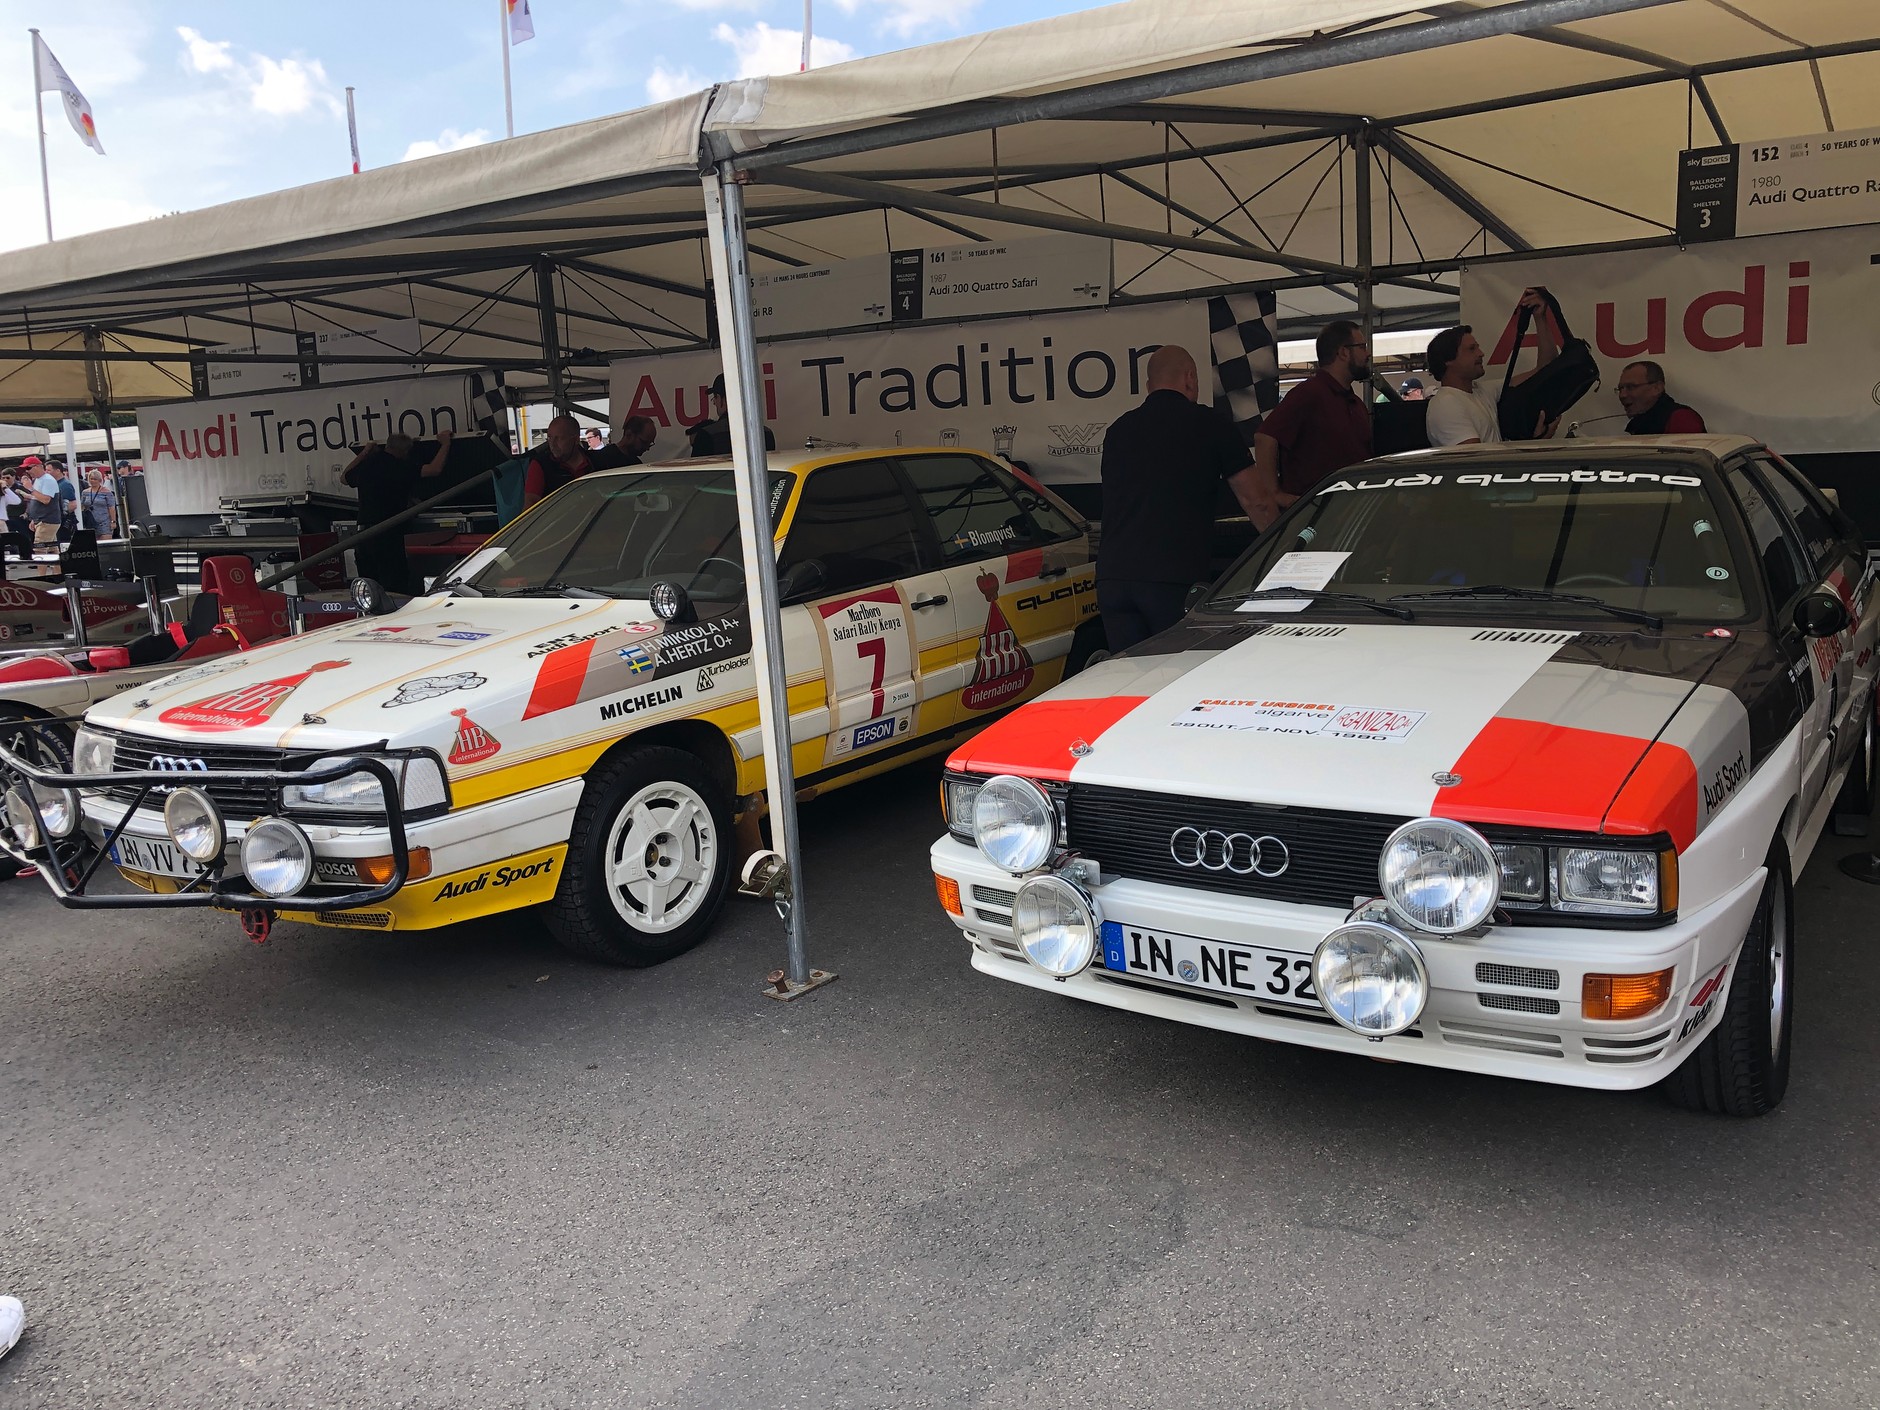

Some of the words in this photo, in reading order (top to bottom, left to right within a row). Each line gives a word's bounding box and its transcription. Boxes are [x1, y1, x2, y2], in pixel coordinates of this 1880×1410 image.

[1752, 146, 1779, 162] 152
[1821, 143, 1832, 152] 50
[1834, 140, 1858, 149] YEARS
[1860, 138, 1870, 146] OF
[1687, 159, 1701, 167] sky
[1703, 155, 1729, 165] sports
[1690, 176, 1726, 186] BALLROOM
[1691, 183, 1724, 191] PADDOCK
[1751, 175, 1781, 188] 1980
[1693, 200, 1720, 208] SHELTER
[1749, 190, 1786, 206] Audi
[1792, 185, 1860, 202] Quattro
[1700, 209, 1711, 228] 3
[930, 252, 945, 263] 161
[929, 286, 950, 296] Audi
[952, 284, 969, 294] 200
[971, 281, 1009, 293] Quattro
[1011, 277, 1038, 289] Safari
[930, 274, 947, 283] 1987
[762, 306, 773, 316] R8
[902, 296, 910, 310] 4
[319, 335, 328, 343] 227
[307, 367, 312, 378] 6
[622, 363, 778, 428] Aui
[151, 413, 239, 461] Audi
[250, 398, 458, 454] Tradition
[992, 425, 1017, 436] HORCH
[1316, 473, 1441, 496] Audi
[1456, 470, 1702, 487] quattro
[968, 526, 1016, 547] Blomqvist
[71, 551, 97, 559] BOSCH
[1017, 579, 1098, 611] quatt
[94, 604, 128, 613] Power
[847, 604, 881, 623] Marlboro
[1082, 604, 1099, 615] MICH
[645, 623, 720, 652] H.MIKKOLA
[721, 618, 740, 630] A+
[833, 625, 857, 641] Safari
[858, 621, 879, 637] Rally
[879, 616, 901, 633] Kenya
[527, 643, 568, 659] Audi
[569, 625, 620, 644] Sport
[655, 639, 712, 668] A.HERTZ
[980, 630, 1021, 683] HB
[706, 656, 751, 676] Turbolader
[857, 637, 887, 720] 7
[201, 684, 294, 712] HB
[970, 674, 1026, 705] international
[600, 685, 683, 721] MICHELIN
[1199, 699, 1257, 707] RALLYE
[1260, 701, 1336, 711] URBIBEL
[168, 710, 253, 727] international
[1254, 709, 1330, 719] algarve
[456, 726, 487, 753] HB
[856, 722, 892, 745] EPSON
[1273, 727, 1320, 735] NOV.
[1331, 732, 1387, 741] 1980
[455, 746, 496, 763] international
[1704, 776, 1727, 815] Audi
[1721, 751, 1748, 795] Sport
[120, 837, 142, 867] IN
[146, 842, 173, 872] YV
[316, 861, 358, 876] BOSCH
[432, 871, 490, 902] Audi
[492, 858, 554, 887] Sport
[1111, 951, 1119, 961] D
[1130, 932, 1173, 975] IN
[1201, 945, 1255, 990] NE
